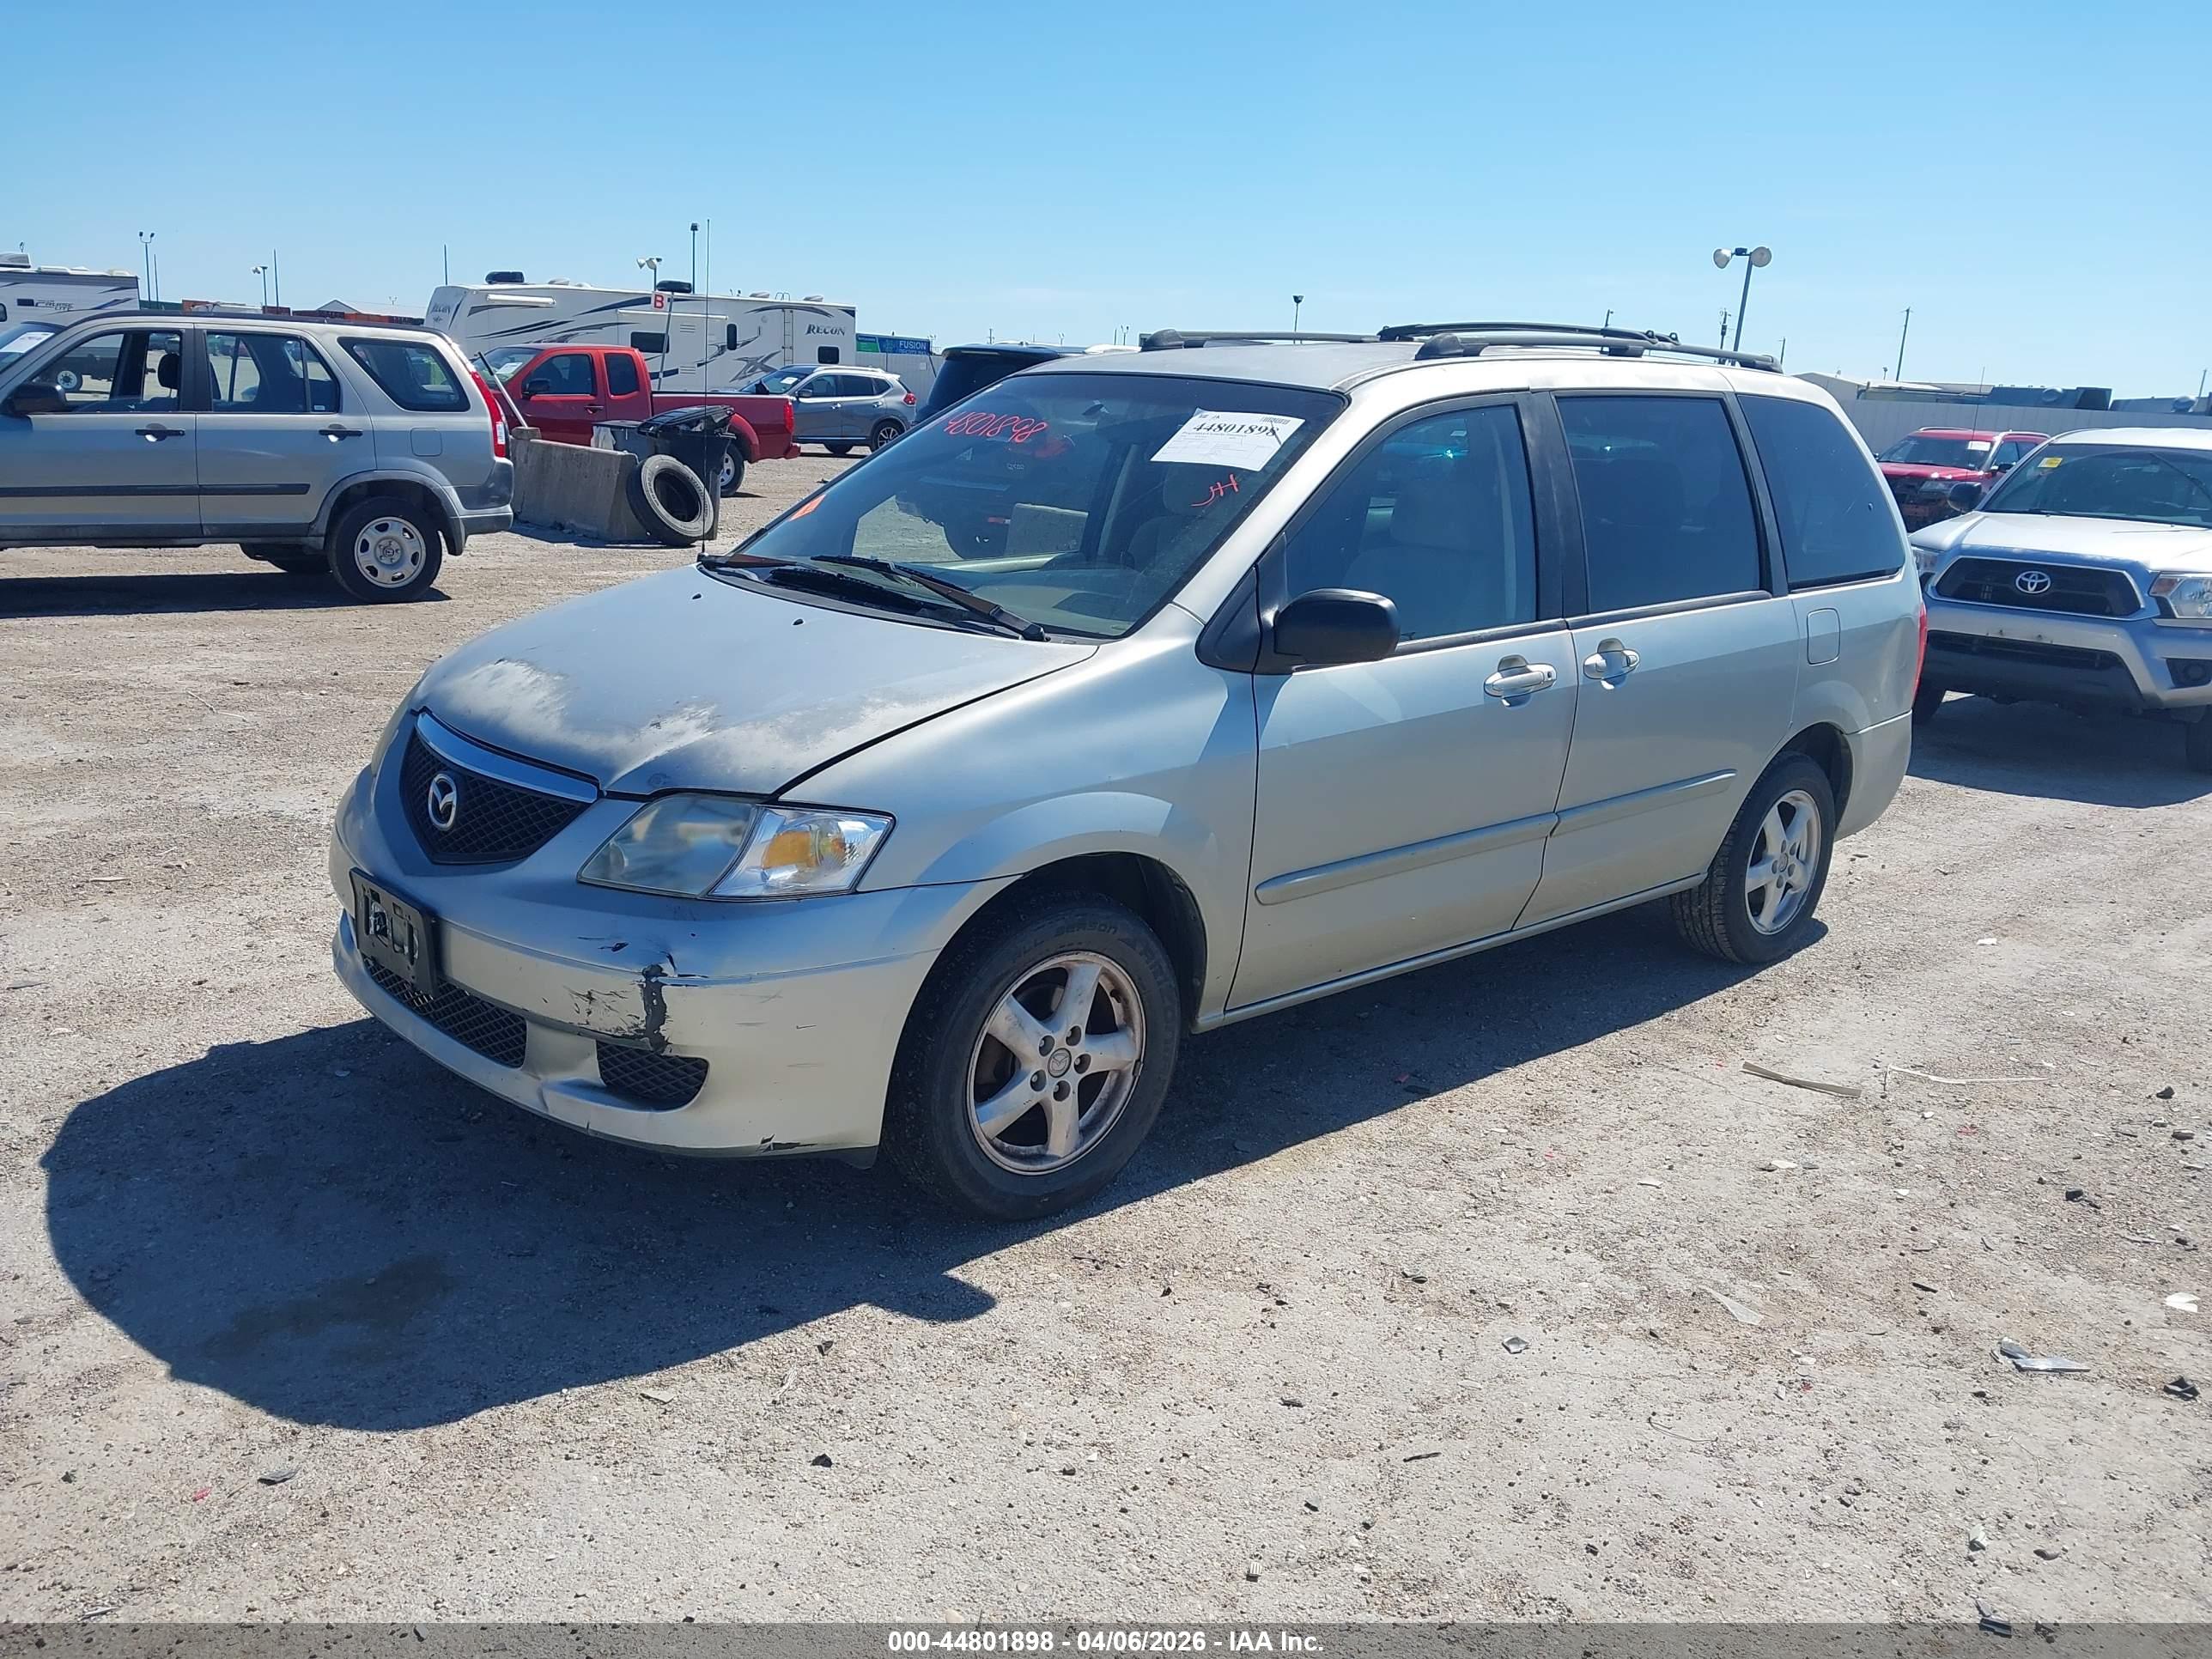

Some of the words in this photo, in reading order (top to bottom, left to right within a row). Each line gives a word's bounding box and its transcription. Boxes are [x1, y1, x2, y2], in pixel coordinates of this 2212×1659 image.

[653, 294, 665, 309] B
[805, 323, 846, 336] RECON
[898, 340, 927, 350] FUSION
[1193, 422, 1279, 437] 44801898
